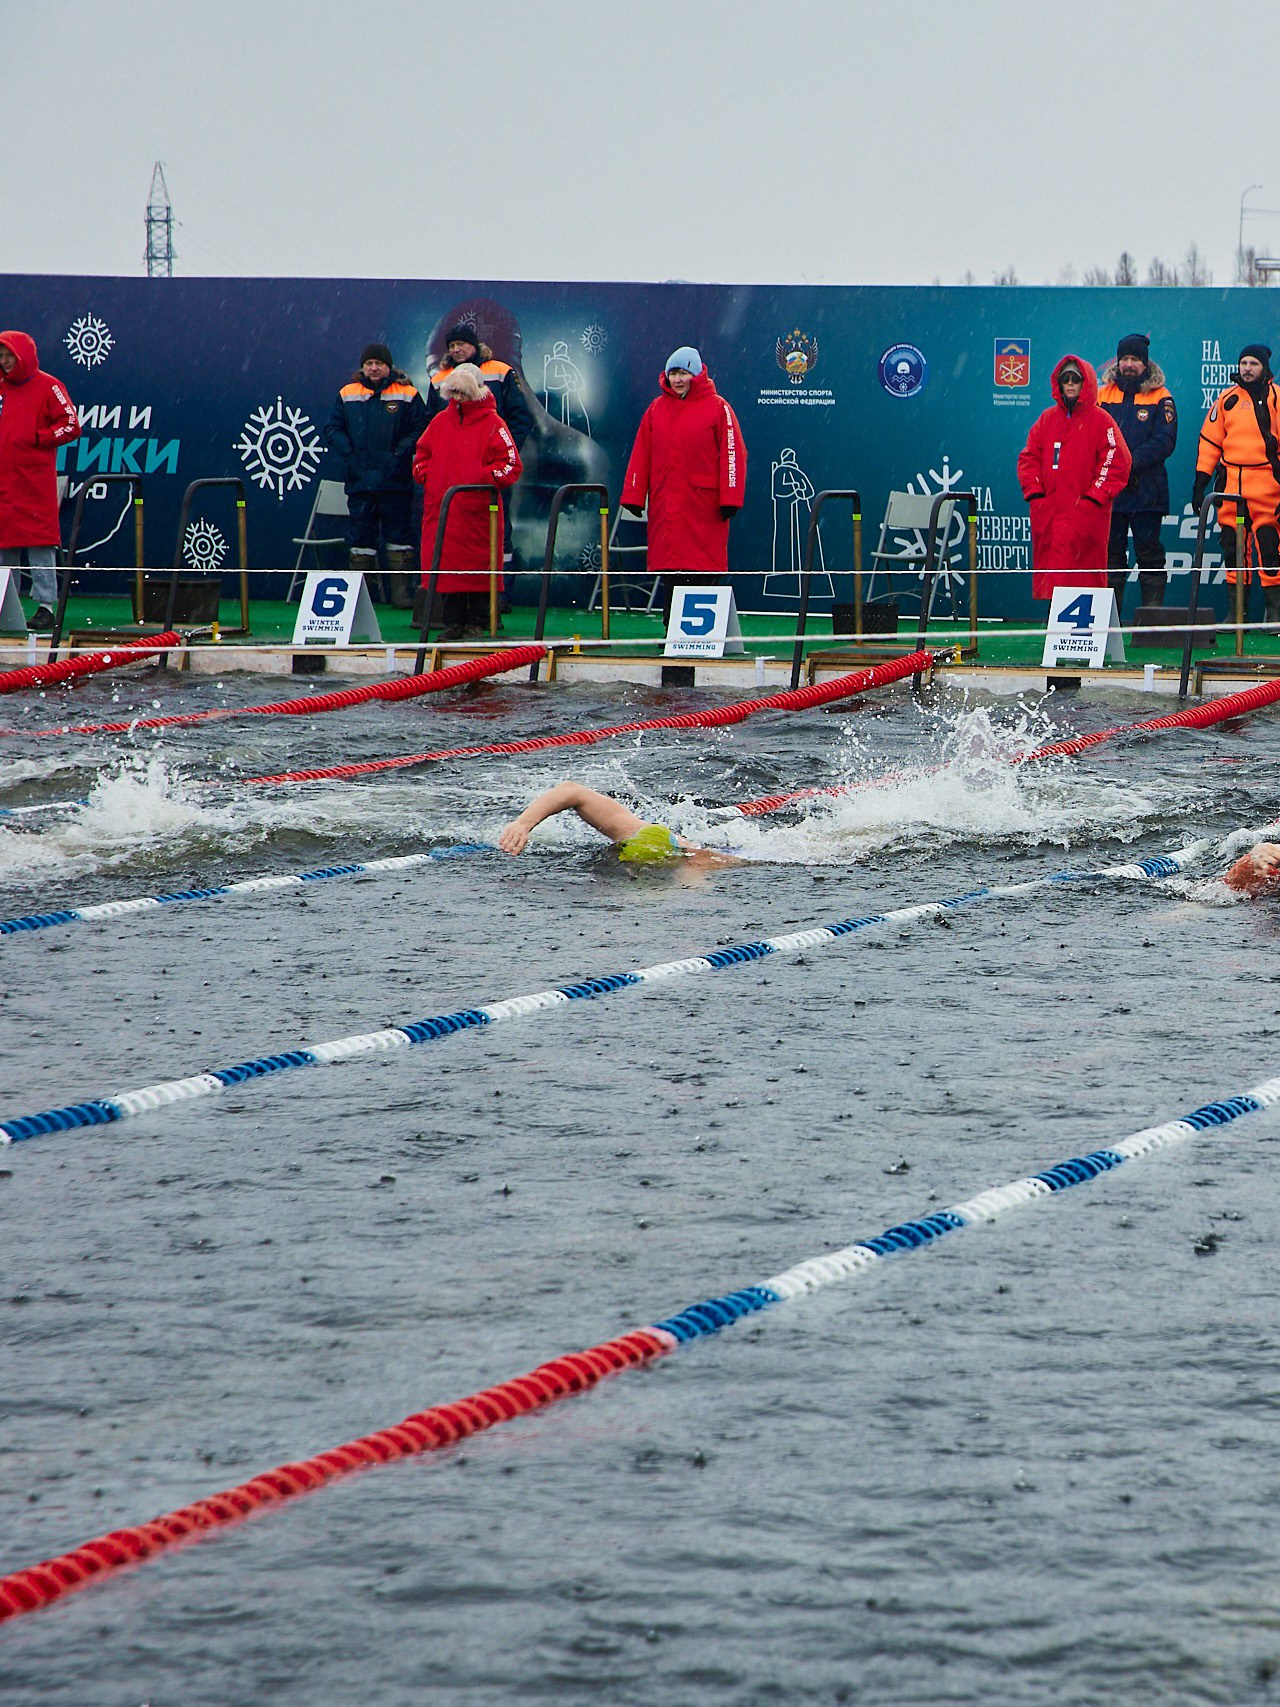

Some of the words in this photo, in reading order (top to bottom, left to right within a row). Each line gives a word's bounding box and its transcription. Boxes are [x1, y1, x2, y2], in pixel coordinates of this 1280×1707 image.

[1202, 340, 1221, 361] НА
[1201, 364, 1239, 386] СЕВЕ
[757, 397, 799, 405] РОССИЙСКОЙ
[800, 398, 836, 406] ФЕДЕРАЦИИ
[760, 389, 808, 397] МИНИСТЕРСТВО
[128, 405, 152, 429] И
[311, 577, 349, 618] 6
[680, 593, 718, 636] 5
[1057, 593, 1096, 637] 4
[1060, 638, 1094, 646] WINTER
